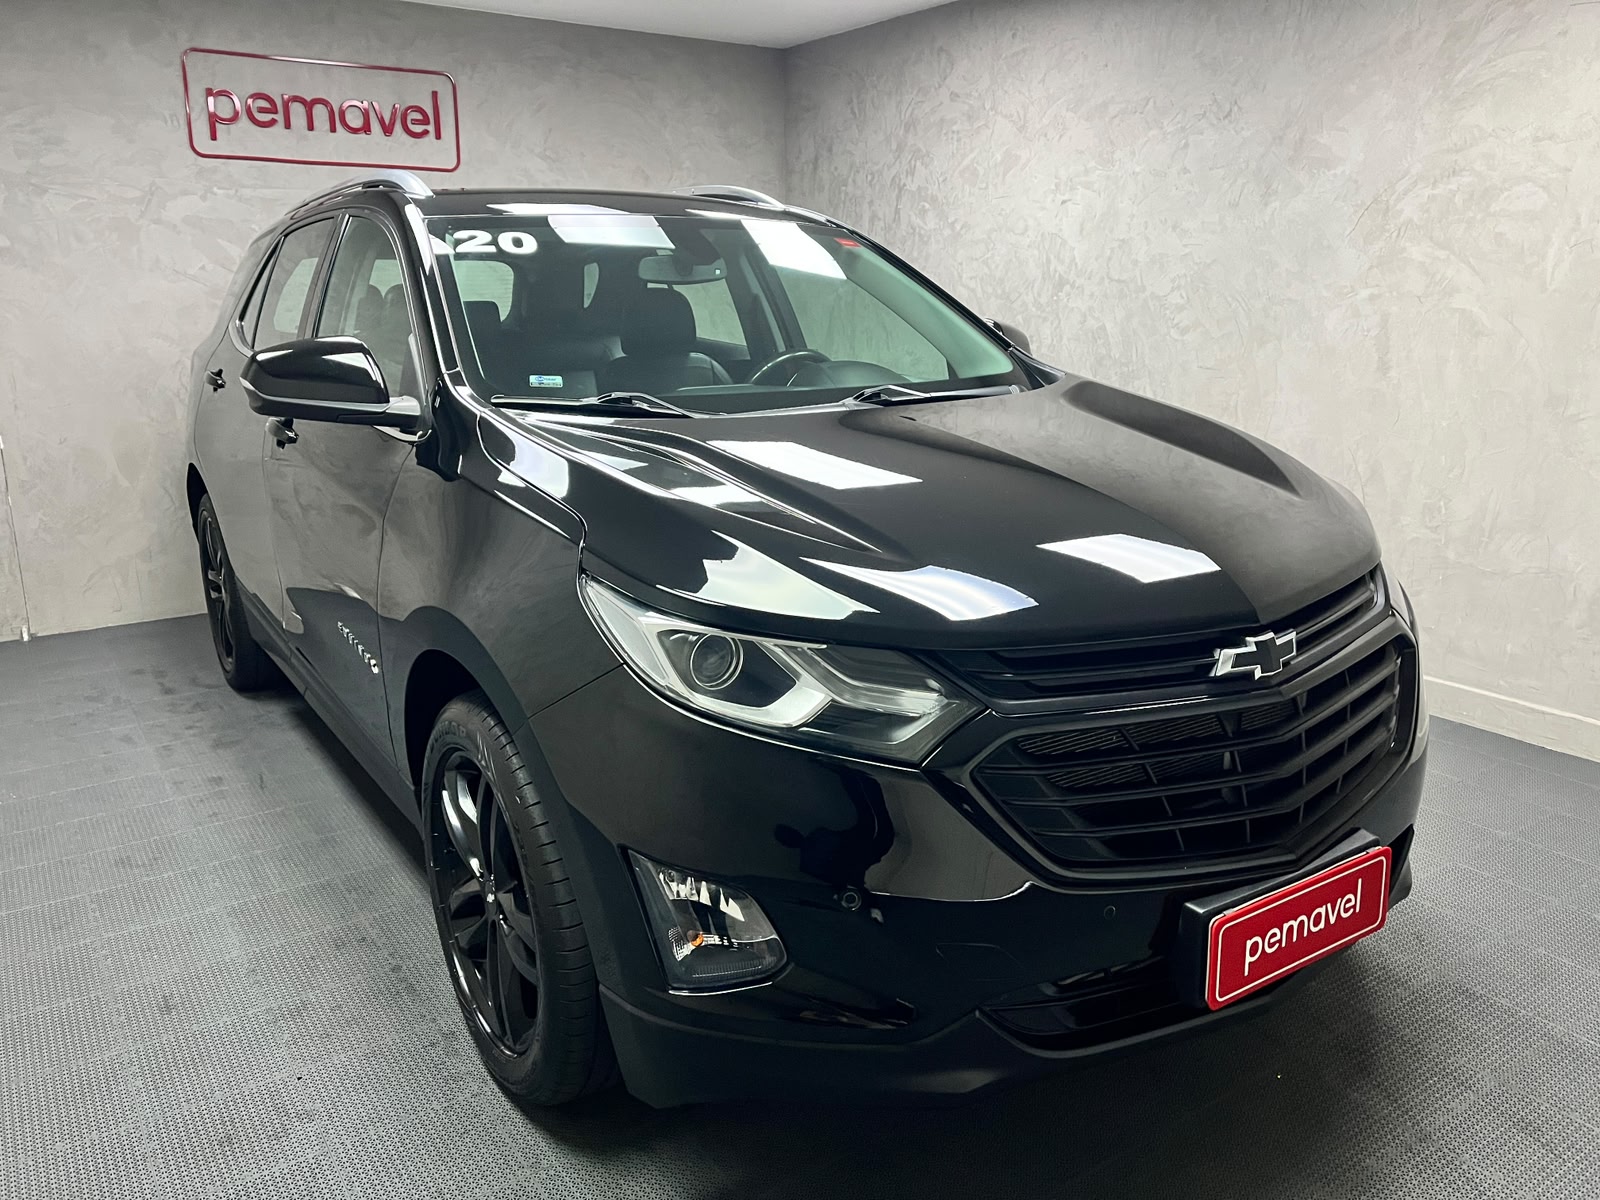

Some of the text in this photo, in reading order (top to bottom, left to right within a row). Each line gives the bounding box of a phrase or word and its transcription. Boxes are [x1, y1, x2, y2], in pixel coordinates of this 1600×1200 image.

[205, 87, 442, 141] pemavel
[452, 229, 538, 255] 20
[1244, 878, 1362, 977] pemavel
